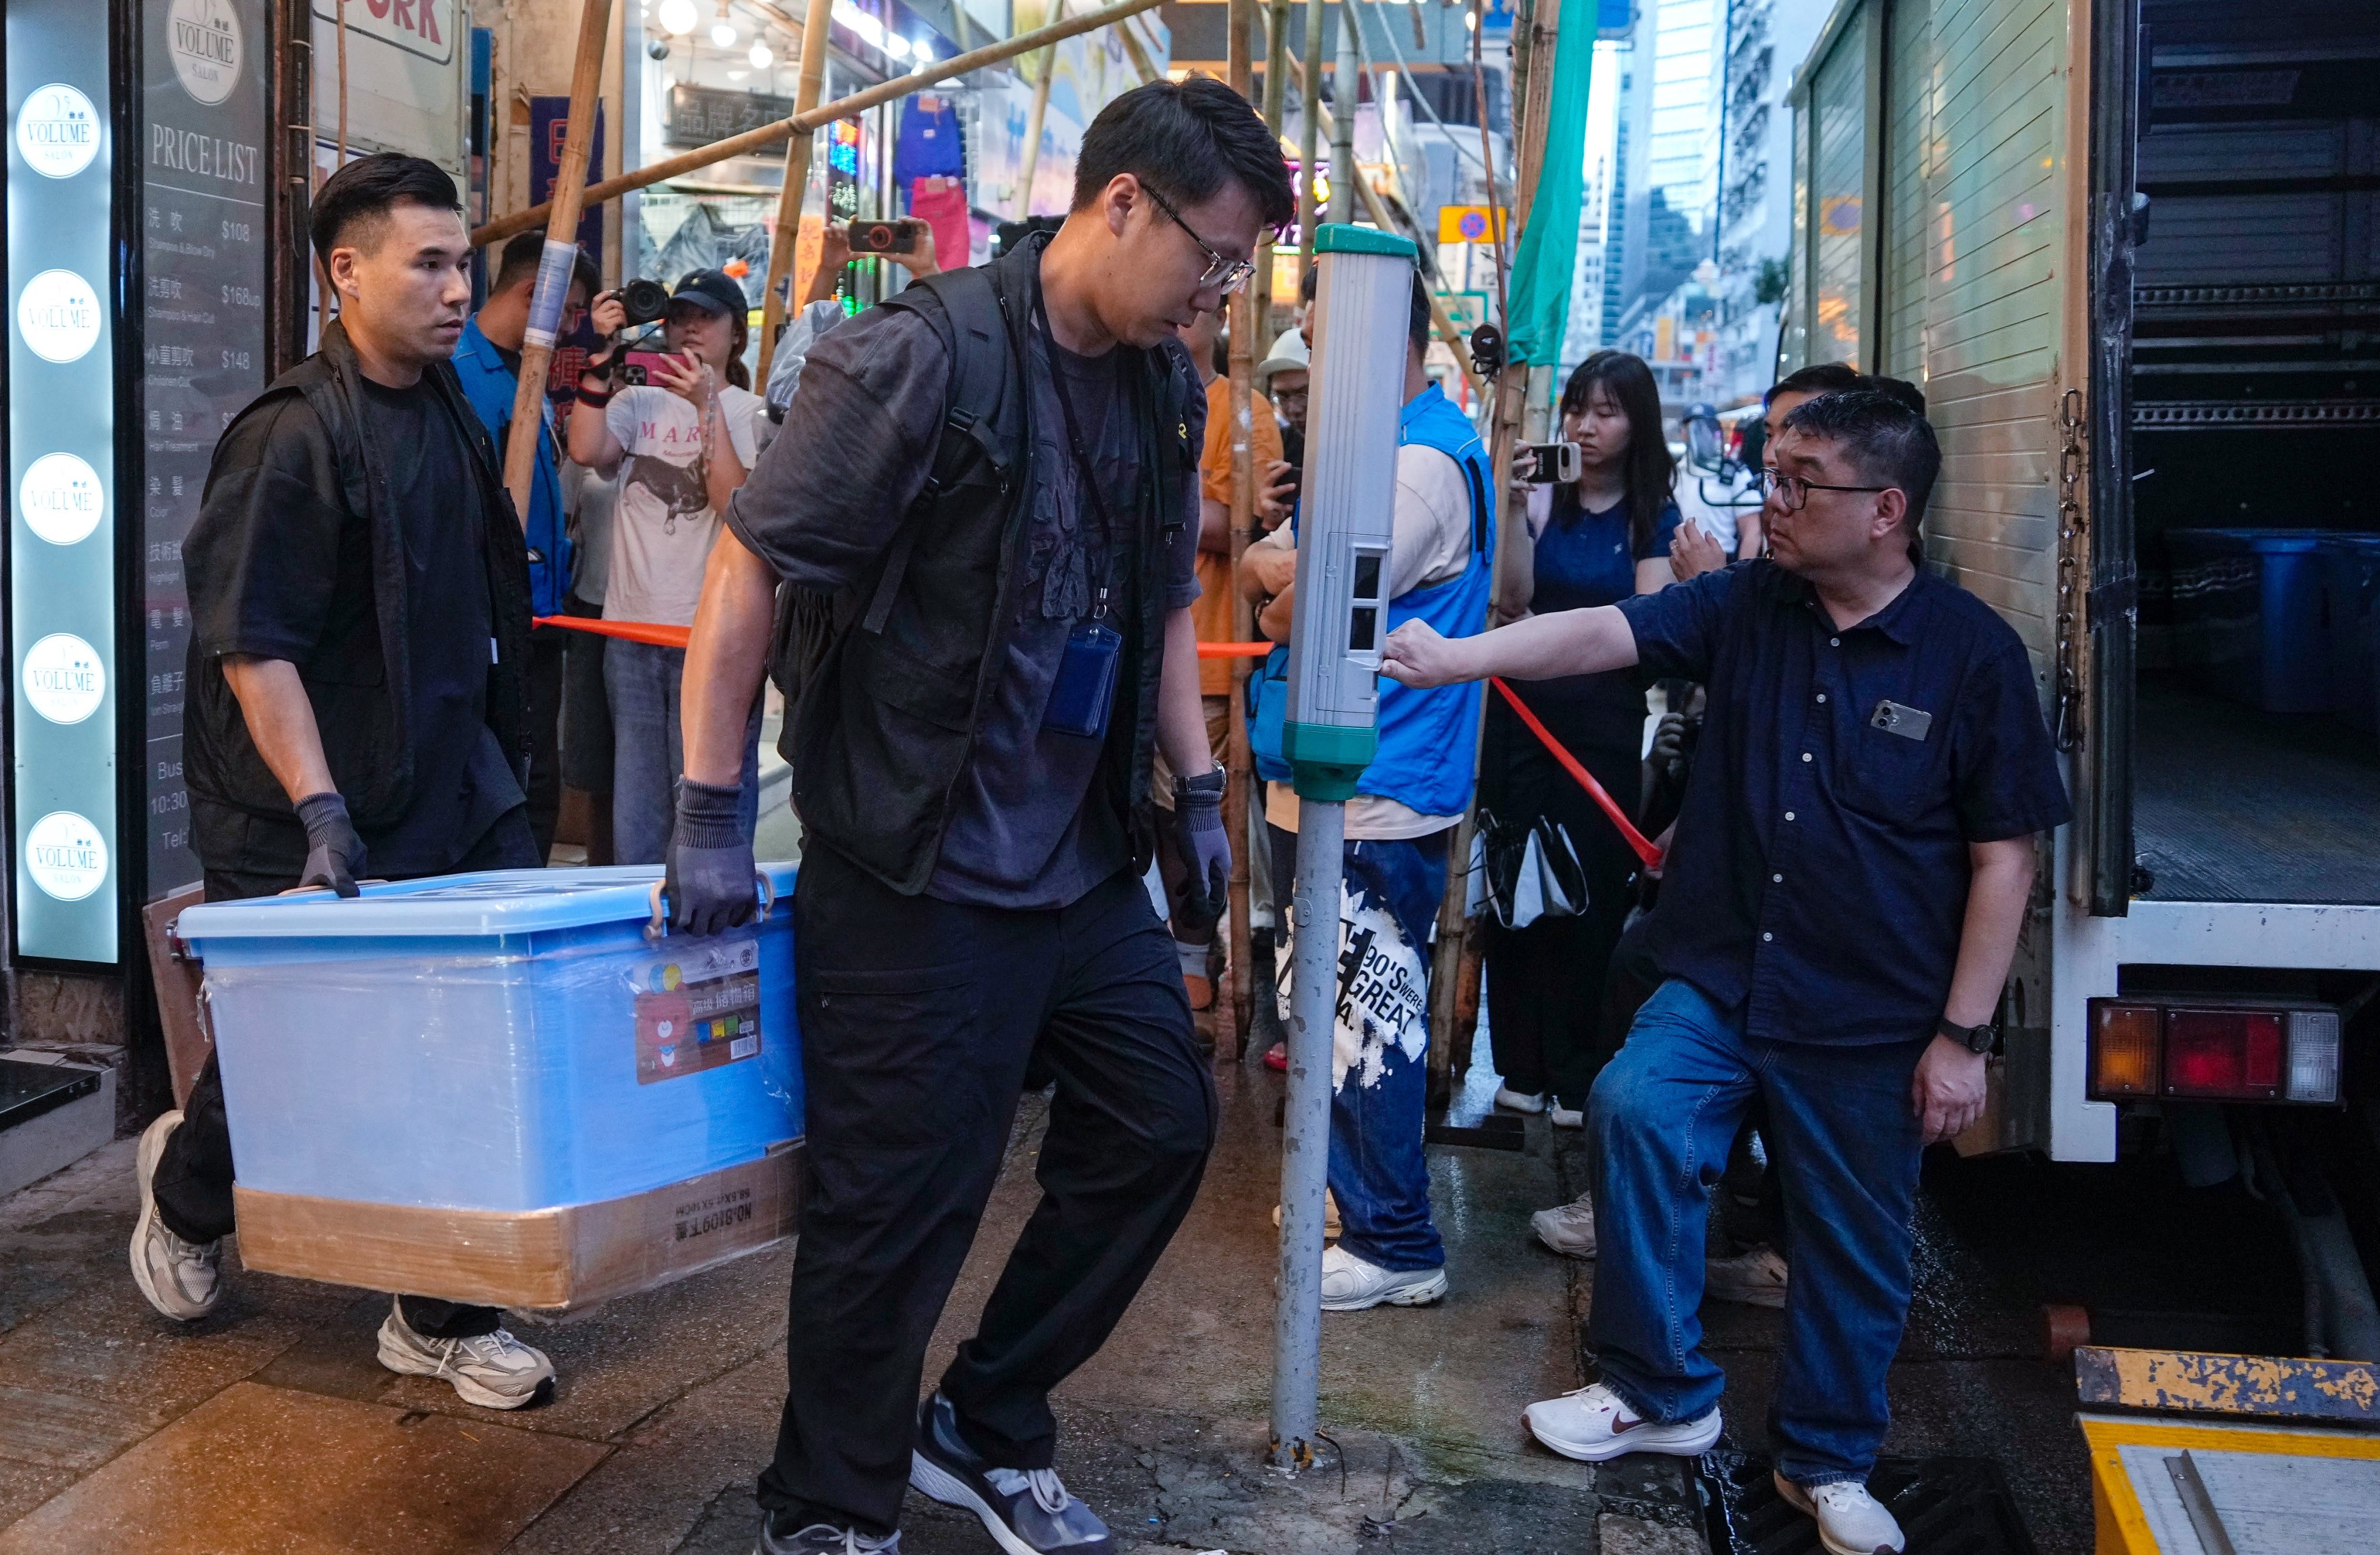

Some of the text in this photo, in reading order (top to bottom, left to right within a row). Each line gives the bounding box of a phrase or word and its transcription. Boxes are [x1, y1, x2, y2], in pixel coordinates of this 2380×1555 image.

[176, 22, 233, 63] VOLUME
[192, 63, 219, 82] SALON
[28, 124, 90, 142] VOLUME
[152, 123, 257, 184] PRICE LIST
[221, 220, 249, 242] $108
[28, 309, 90, 327] VOLUME
[221, 351, 250, 369] $148
[31, 491, 92, 510] VOLUME
[34, 670, 94, 691] VOLUME
[36, 848, 98, 869] VOLUME
[1363, 945, 1423, 1012] 90'S WERE
[1348, 970, 1416, 1035] GREAT
